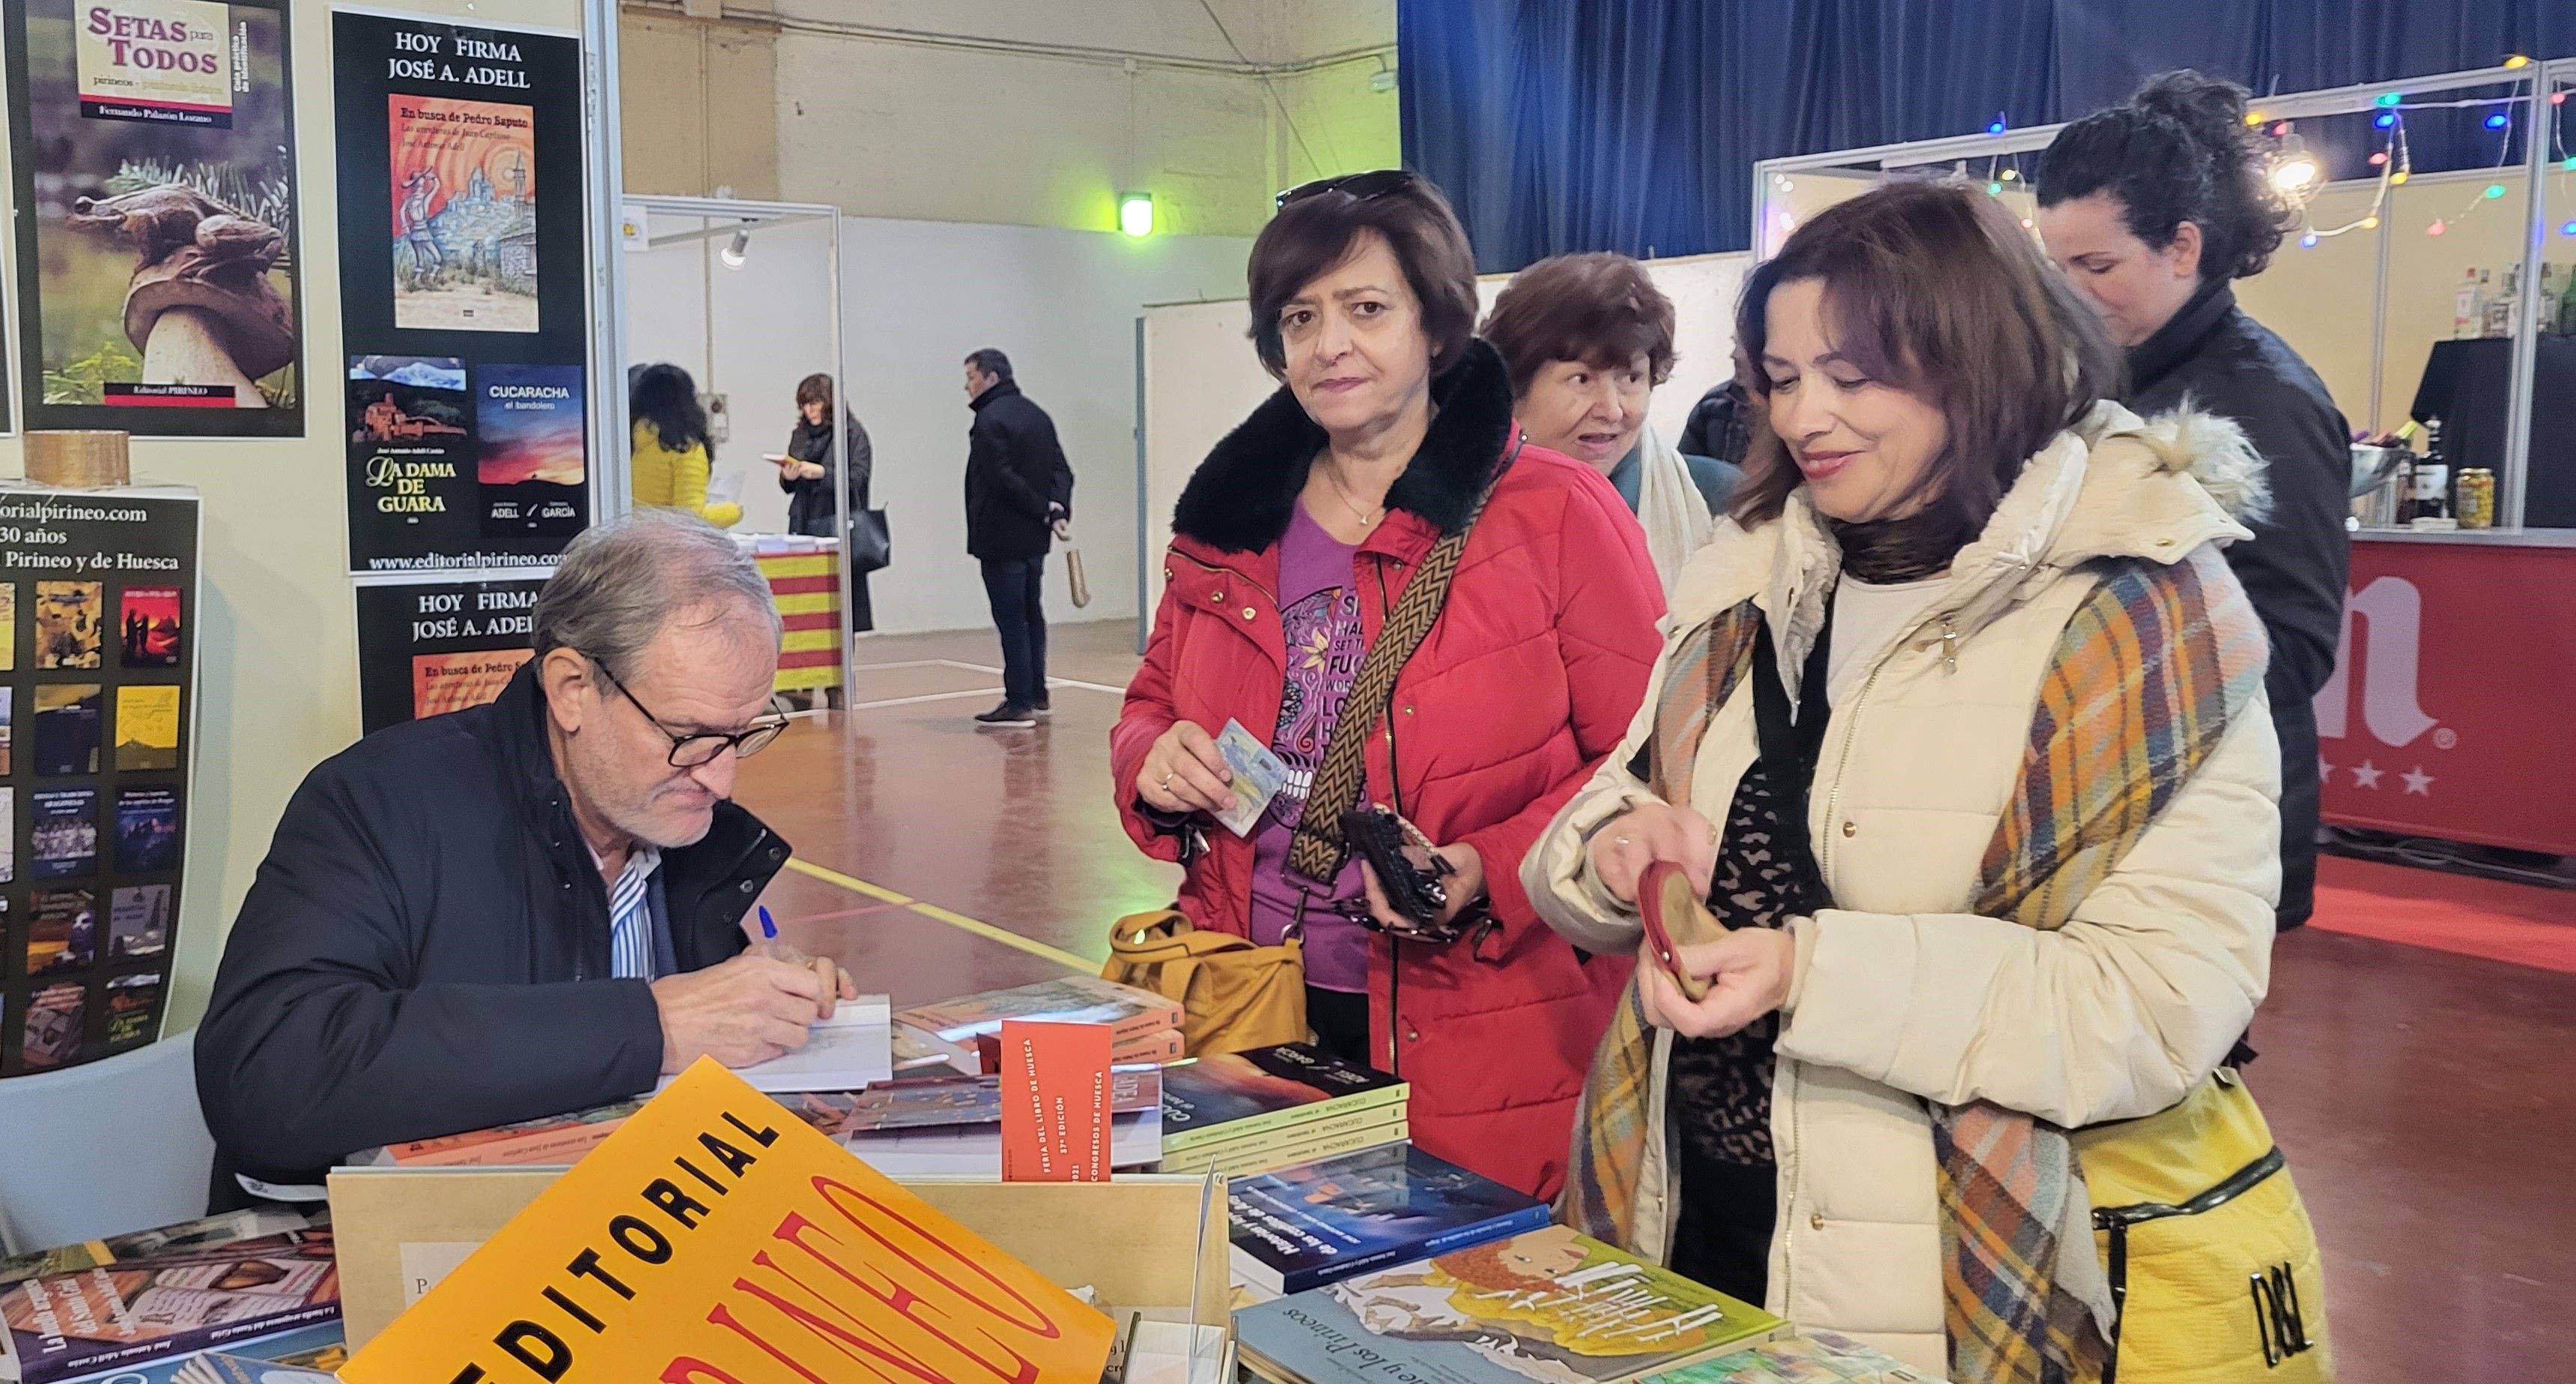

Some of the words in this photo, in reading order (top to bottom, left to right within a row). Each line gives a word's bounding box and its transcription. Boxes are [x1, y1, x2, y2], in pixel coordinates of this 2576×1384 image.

[88, 6, 186, 42] SETAS
[107, 37, 218, 74] TODOS
[395, 31, 442, 54] HOY
[455, 39, 522, 62] FIRMA
[388, 58, 436, 80] JOSÉ
[439, 64, 460, 82] A.
[464, 67, 531, 88] ADELL
[401, 108, 416, 118] En
[419, 109, 447, 121] busca
[449, 112, 461, 122] de
[463, 113, 492, 124] Pedro
[494, 115, 528, 129] Saputo
[488, 385, 570, 398] CUCARACHA
[405, 463, 457, 477] DAMA
[398, 479, 425, 494] DE
[377, 496, 446, 512] GUARA
[491, 508, 520, 518] ADELL
[541, 506, 576, 518] GARCÍA
[24, 527, 67, 544] años
[5, 550, 72, 568] Pirineo
[76, 556, 88, 574] y
[91, 552, 113, 569] de
[116, 553, 180, 570] Huesca
[419, 594, 464, 613] HOY
[412, 616, 458, 643] JOSÉ
[461, 619, 482, 637] A.
[1334, 640, 1352, 651] SET
[1023, 1039, 1036, 1076] HUESCA
[1030, 1079, 1039, 1092] DE
[1093, 1071, 1103, 1109] HUESCA
[1032, 1094, 1044, 1123] LIBRO
[1055, 1096, 1066, 1136] EDICIÓN
[1093, 1111, 1101, 1124] DE
[1037, 1126, 1047, 1143] DEL
[1040, 1146, 1051, 1174] FERIA
[1091, 1126, 1100, 1182] CONGRESOS
[1072, 1164, 1080, 1183] 021
[1282, 1308, 1360, 1353] Pirineos
[1353, 1349, 1389, 1369] los
[1382, 1362, 1408, 1374] y
